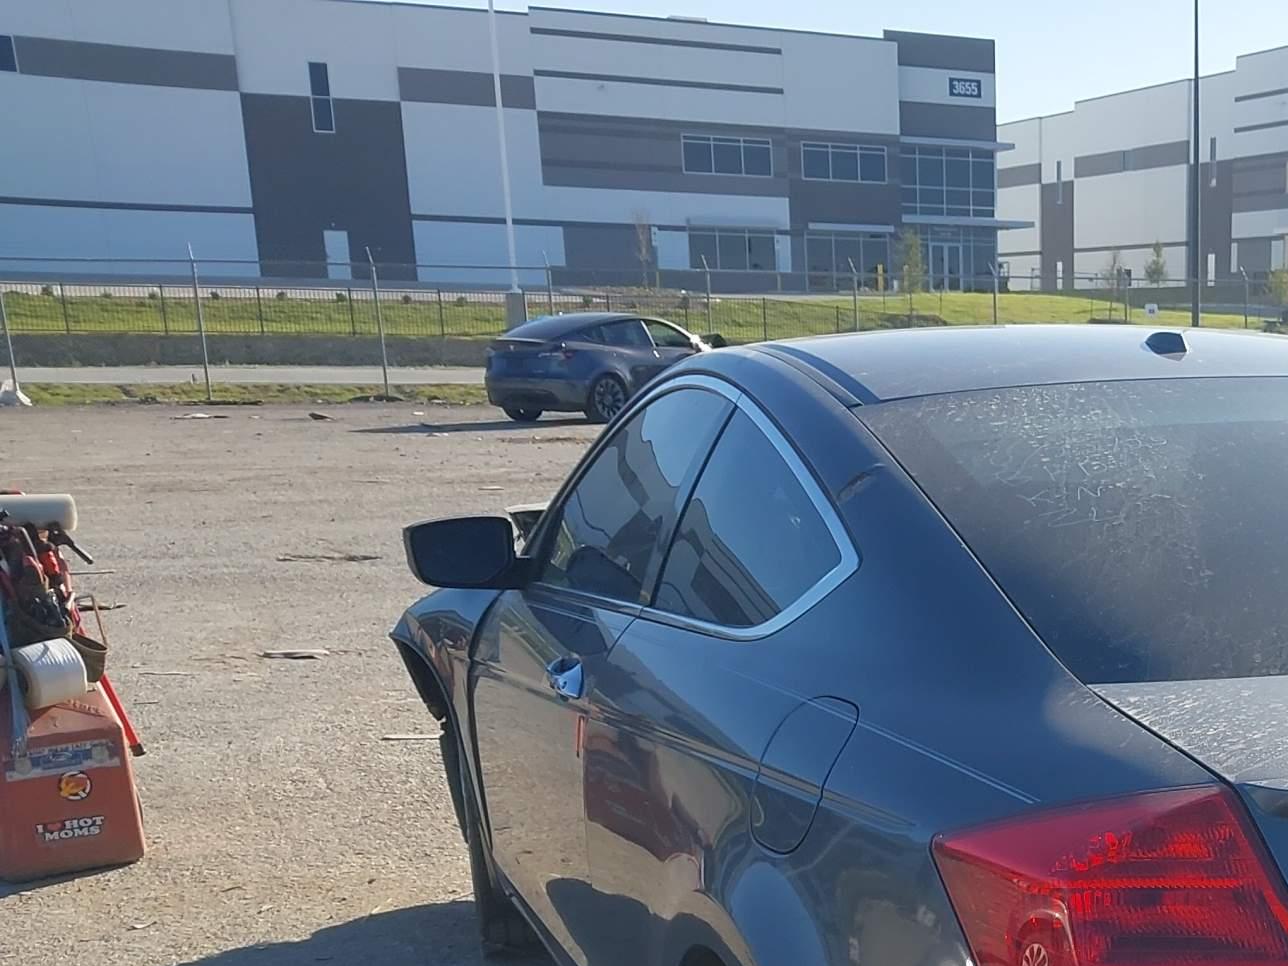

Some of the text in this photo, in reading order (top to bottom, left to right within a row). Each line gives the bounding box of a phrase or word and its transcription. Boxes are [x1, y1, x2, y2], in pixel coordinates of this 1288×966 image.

[952, 81, 978, 95] 3655
[64, 816, 105, 830] HOT
[45, 826, 101, 841] MOMS
